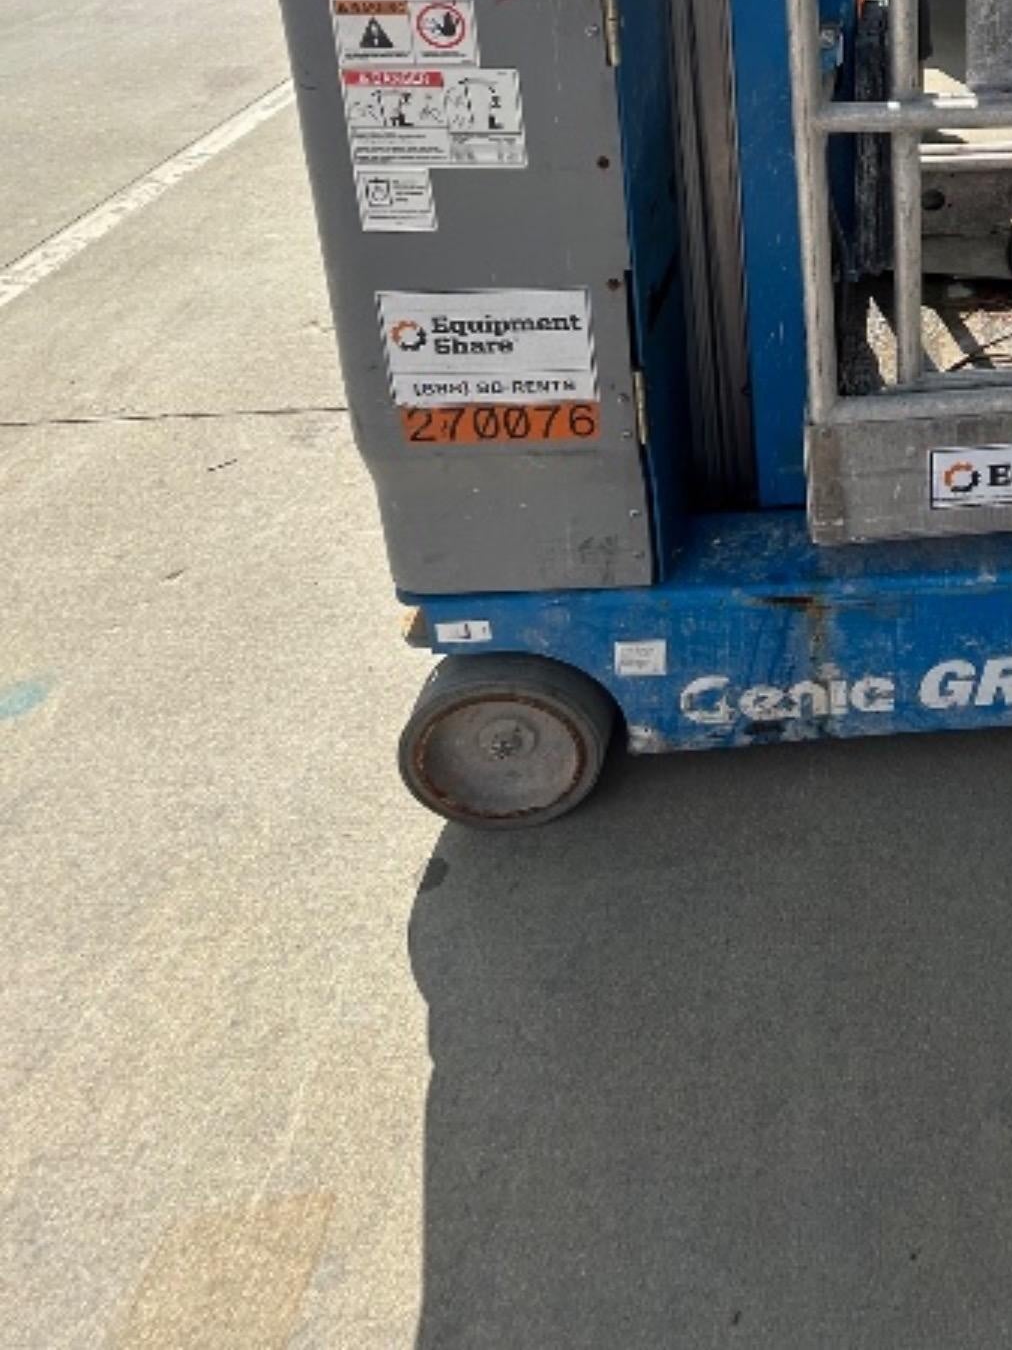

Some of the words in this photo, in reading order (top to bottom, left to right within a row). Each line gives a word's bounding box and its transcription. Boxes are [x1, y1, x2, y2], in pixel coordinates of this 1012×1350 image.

[431, 314, 583, 337] Equipment
[434, 337, 514, 355] Share
[406, 403, 596, 443] 270076
